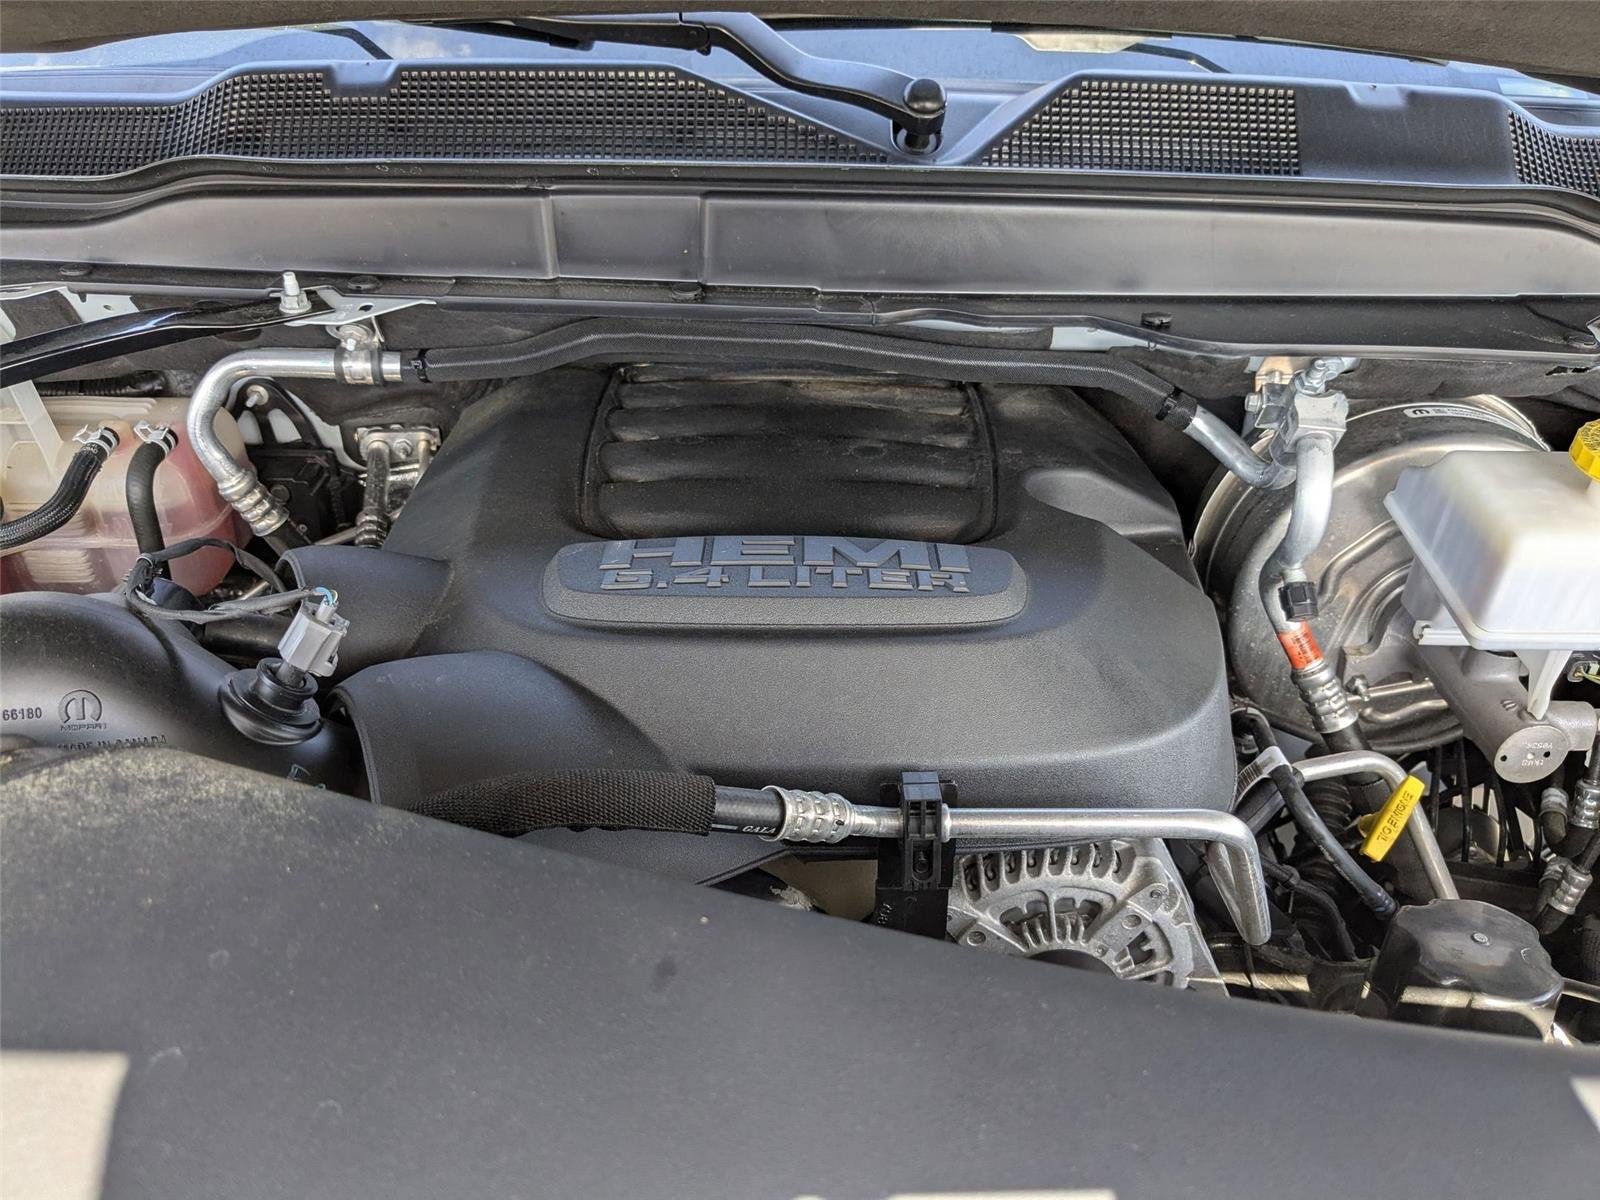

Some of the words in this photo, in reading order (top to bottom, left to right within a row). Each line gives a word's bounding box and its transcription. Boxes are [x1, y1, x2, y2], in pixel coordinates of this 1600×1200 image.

[599, 535, 972, 574] HEMI
[599, 566, 730, 590] 6.4
[747, 564, 971, 593] LITER
[2, 706, 43, 721] 66180
[1387, 790, 1415, 829] ENGINE
[1376, 826, 1393, 842] OIL
